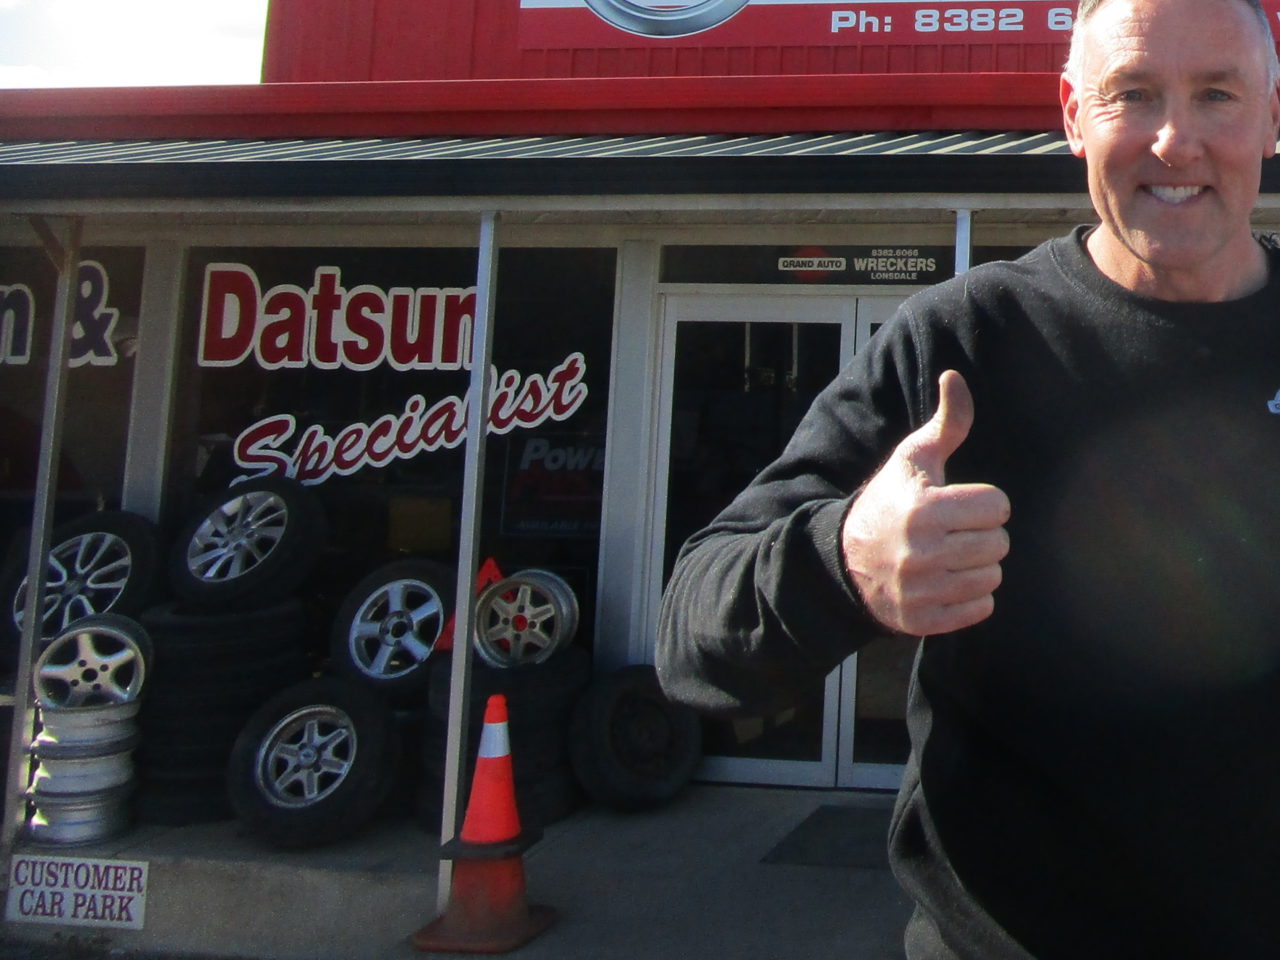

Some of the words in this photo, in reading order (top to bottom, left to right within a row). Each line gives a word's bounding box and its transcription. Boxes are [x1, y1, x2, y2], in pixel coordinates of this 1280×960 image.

[830, 10, 892, 34] Ph:
[914, 8, 1025, 33] 8382
[781, 259, 814, 269] GRAND
[816, 259, 843, 269] AUTO
[853, 257, 937, 271] WRECKERS
[870, 272, 918, 280] LONSDALE
[14, 859, 144, 893] CUSTOMER
[19, 889, 65, 918] CAR
[71, 892, 135, 922] PARK
